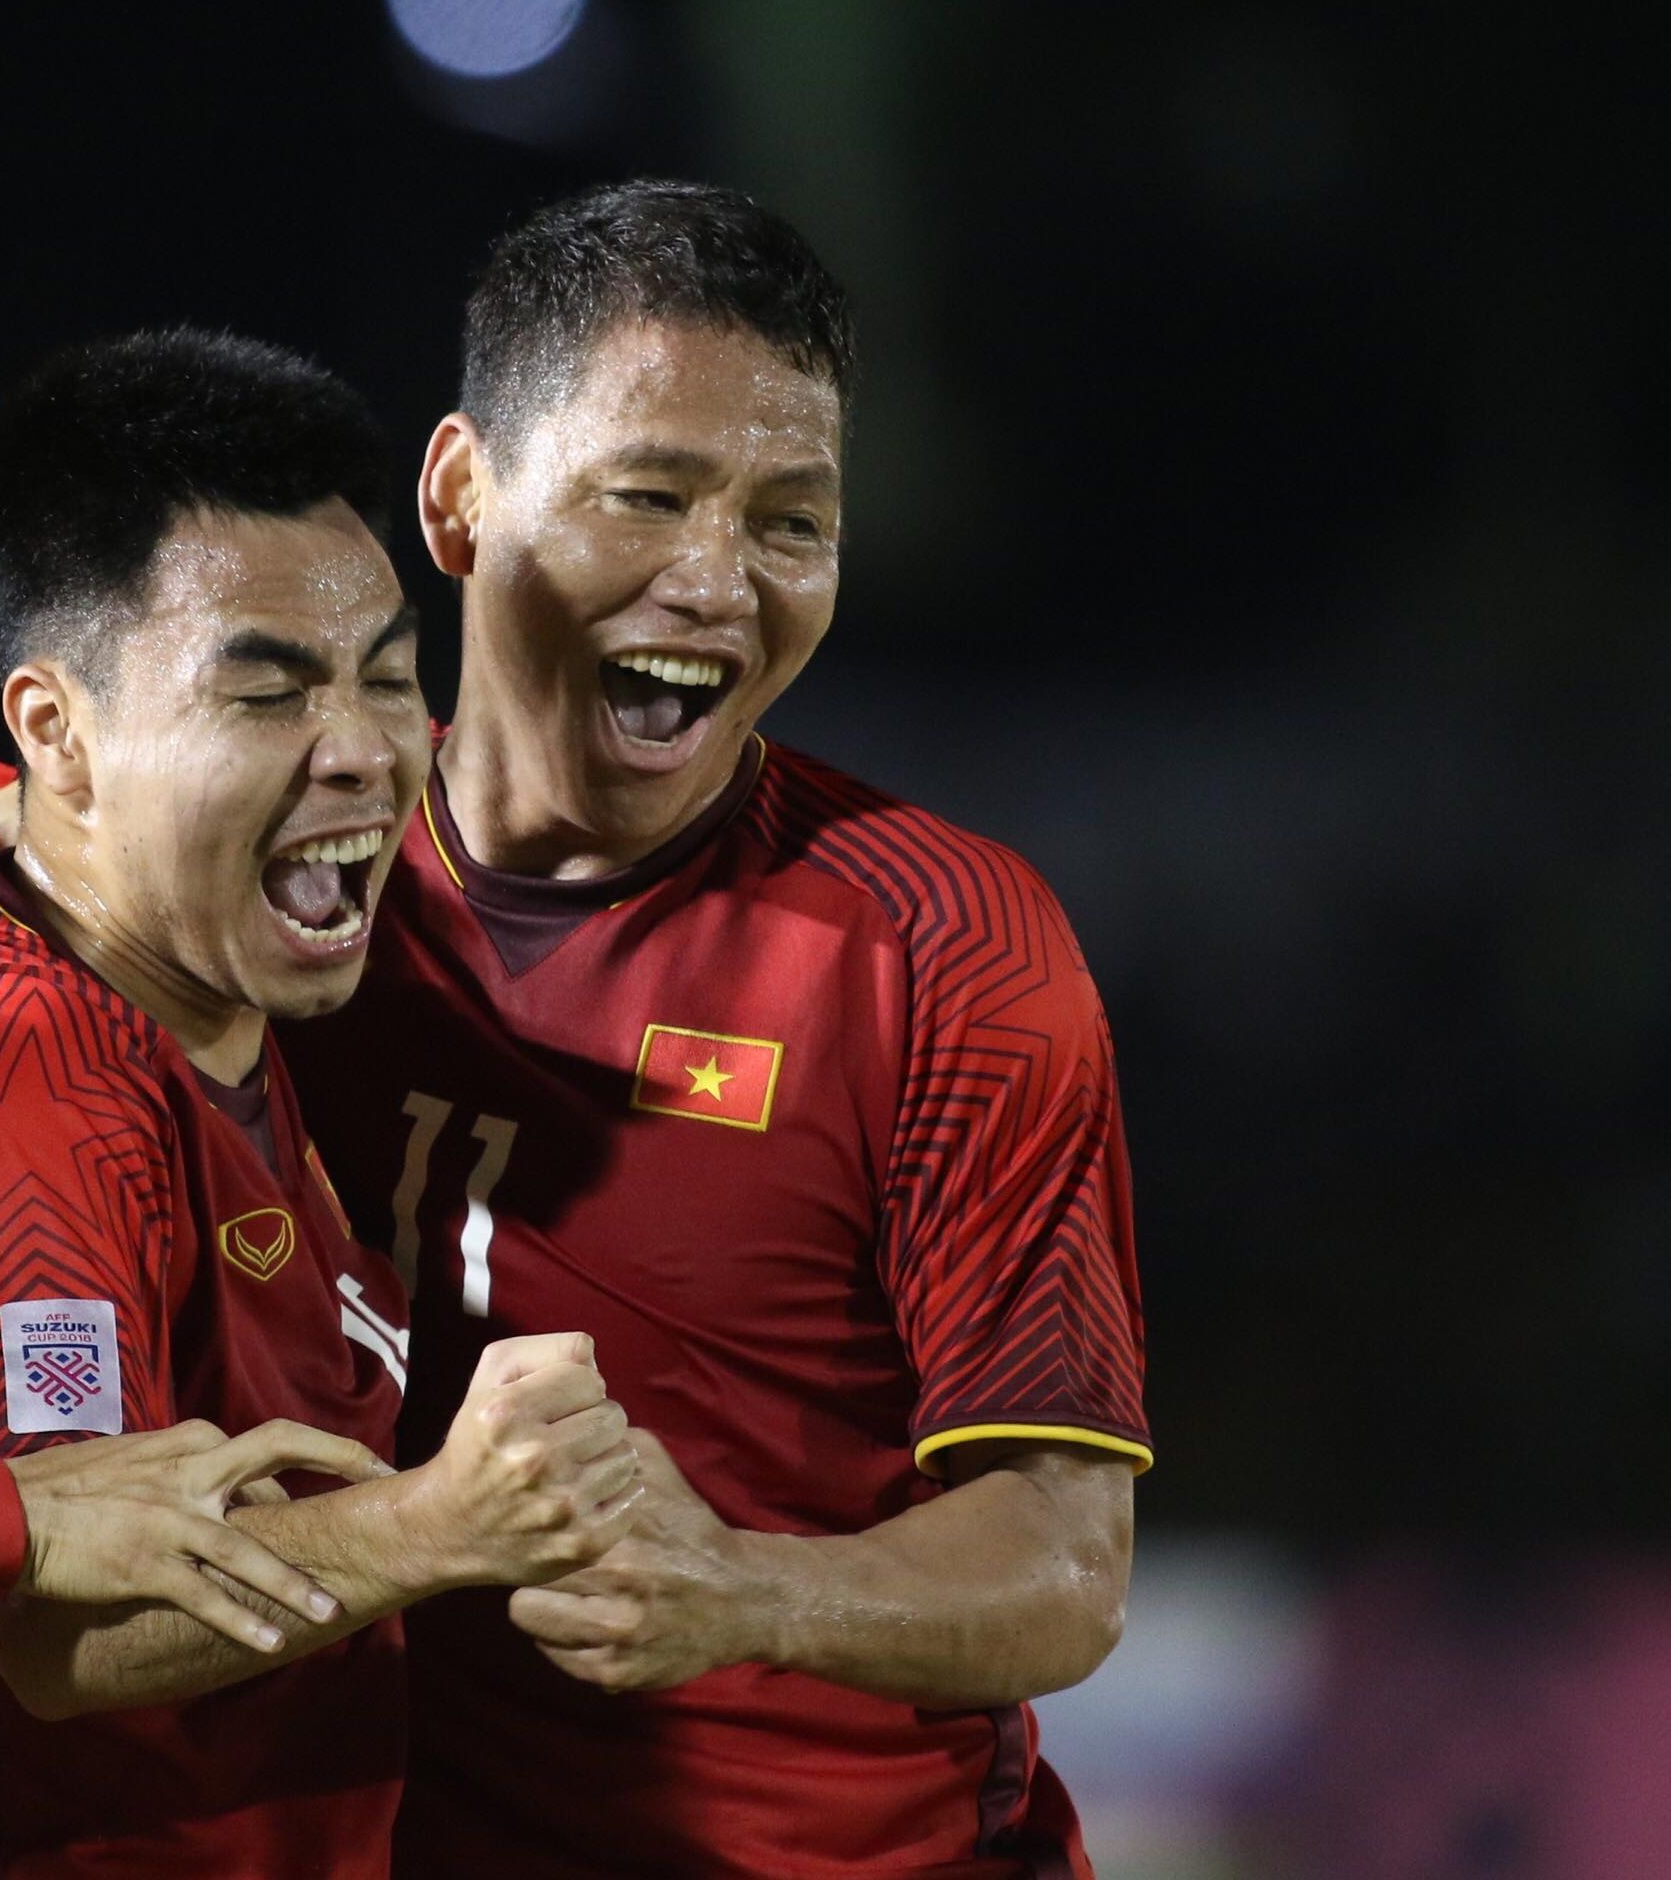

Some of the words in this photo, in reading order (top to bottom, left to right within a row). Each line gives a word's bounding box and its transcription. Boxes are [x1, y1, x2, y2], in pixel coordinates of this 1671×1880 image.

[392, 1090, 518, 1318] 11
[45, 1313, 71, 1321] AFF
[20, 1322, 97, 1334] SUZUKI
[27, 1333, 56, 1342] CUP
[59, 1333, 92, 1343] 2018
